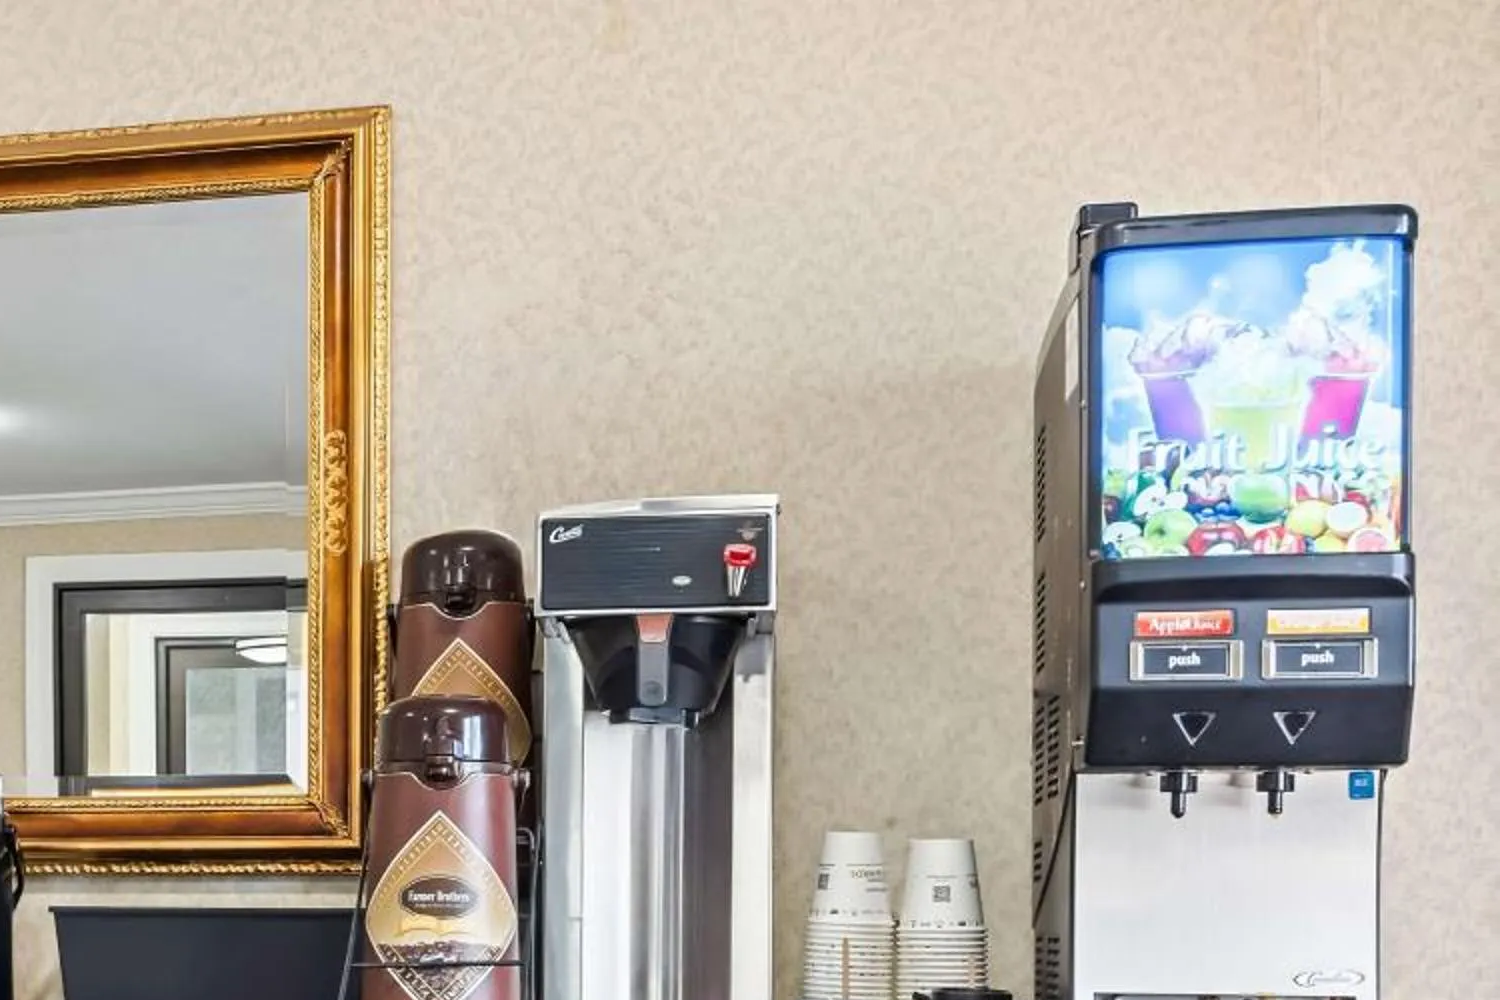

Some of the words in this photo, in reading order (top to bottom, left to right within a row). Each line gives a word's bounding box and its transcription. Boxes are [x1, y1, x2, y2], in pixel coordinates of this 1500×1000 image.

[1128, 426, 1246, 473] Fruit
[1255, 422, 1388, 474] Juice
[1168, 651, 1201, 669] push
[1301, 649, 1335, 668] push
